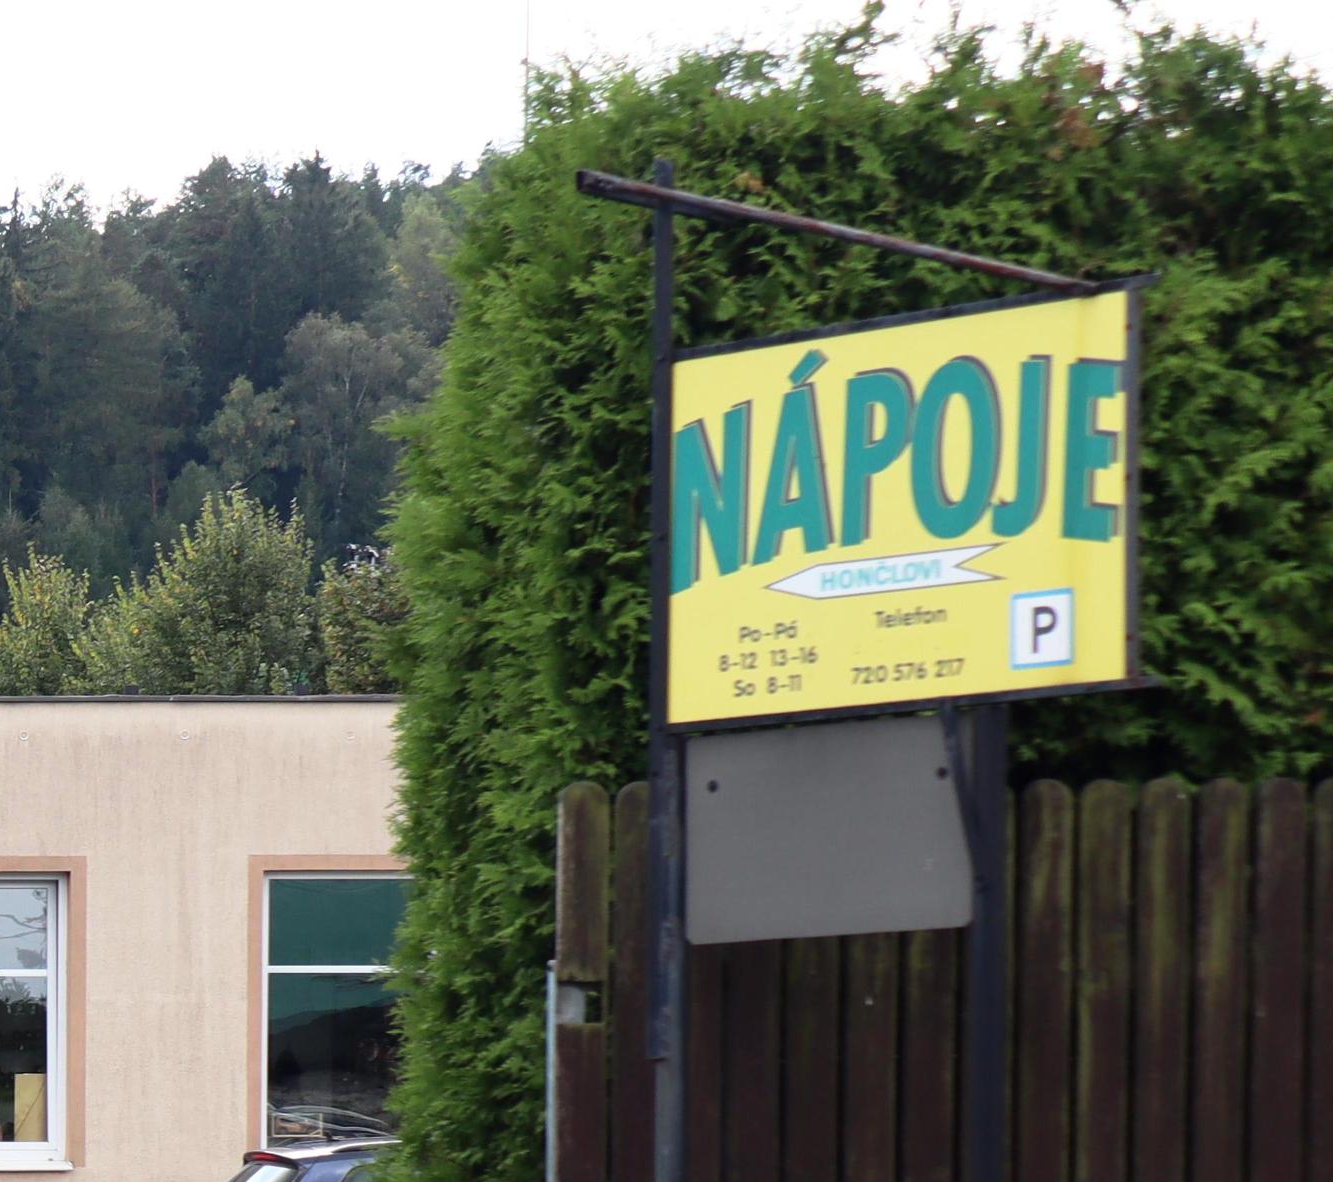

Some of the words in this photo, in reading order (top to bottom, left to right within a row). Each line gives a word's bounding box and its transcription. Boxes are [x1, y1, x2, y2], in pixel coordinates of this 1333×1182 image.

[670, 349, 1125, 597] NÁPOJE
[820, 559, 942, 592] HONČLOVI
[874, 606, 948, 629] Telefon
[851, 665, 888, 686] 720
[892, 662, 928, 683] 576
[934, 658, 965, 679] 217
[732, 679, 756, 698] So
